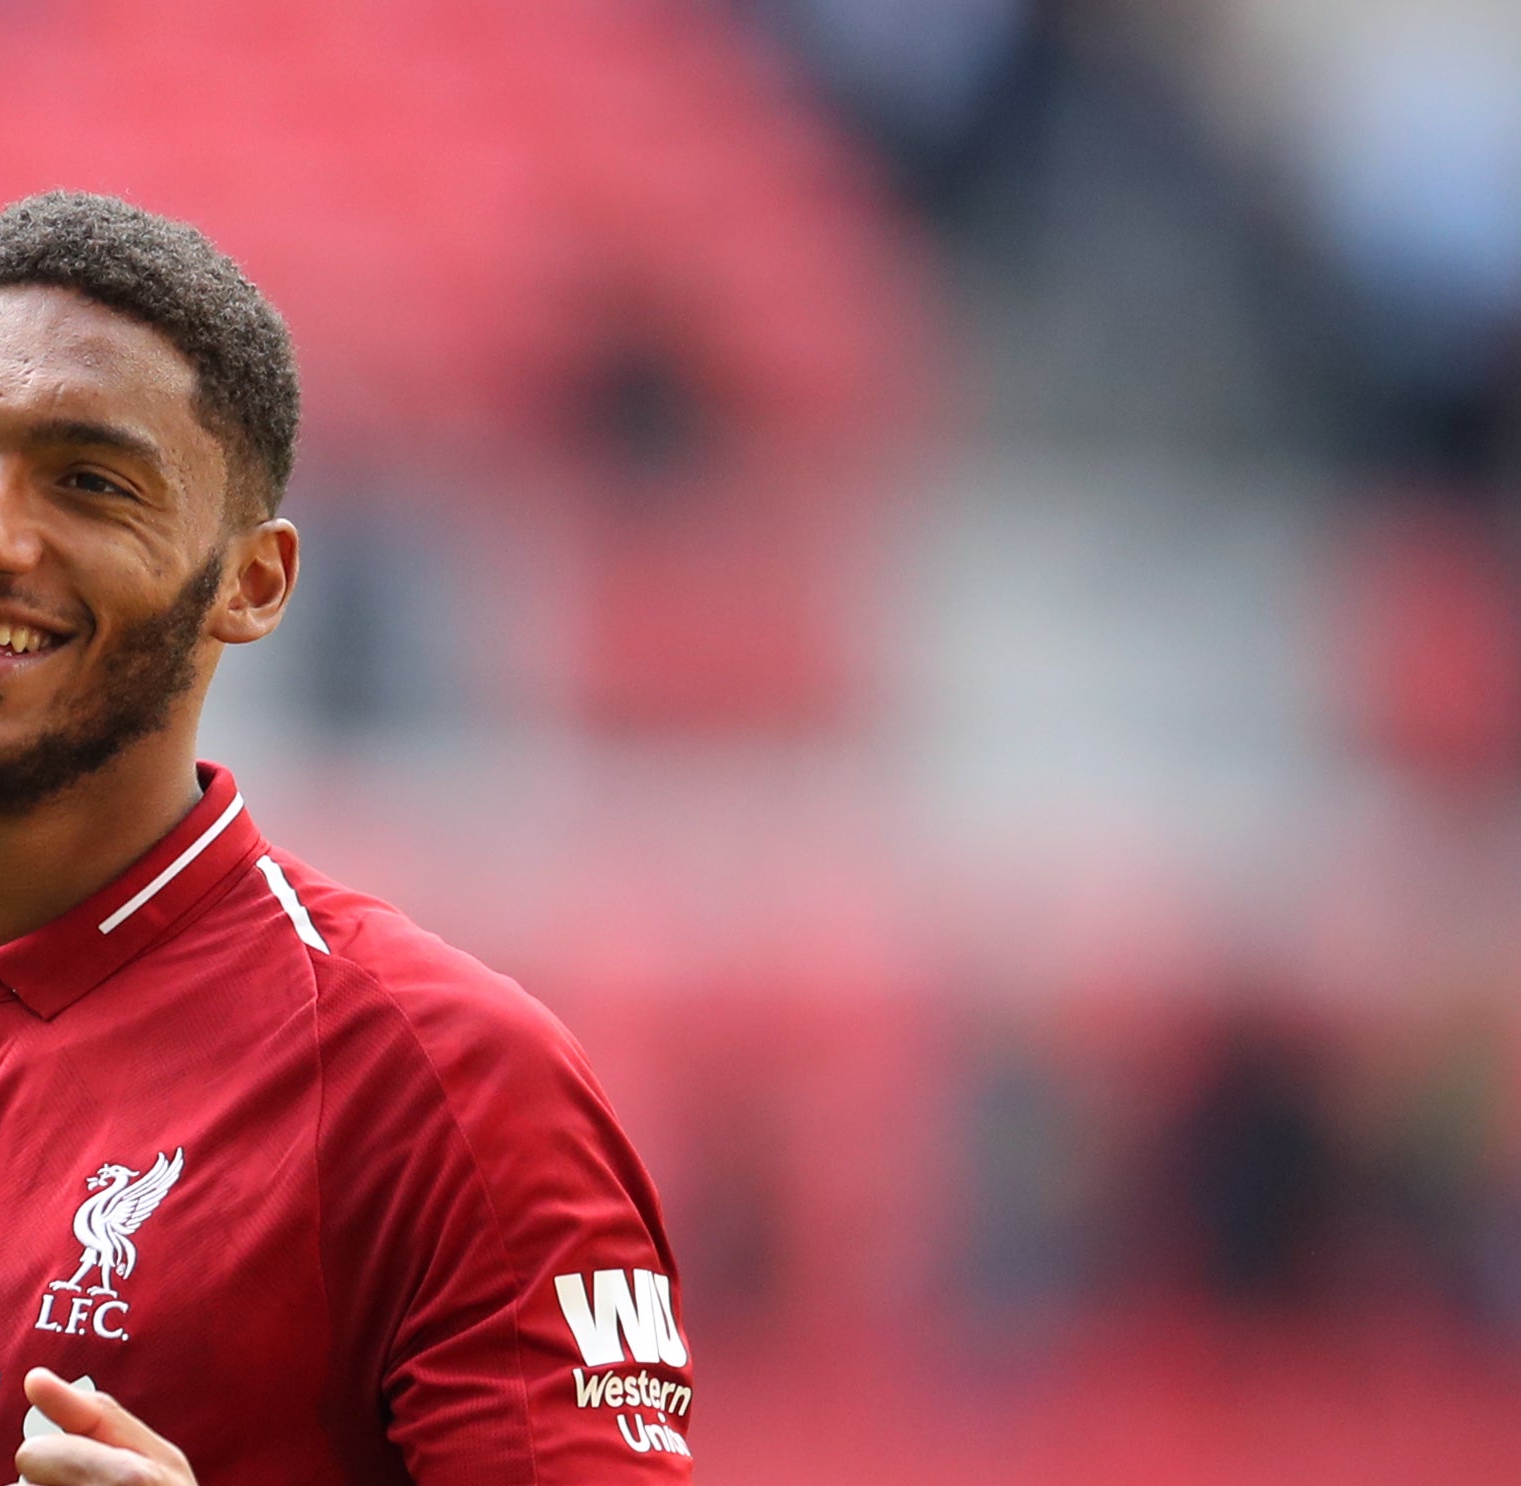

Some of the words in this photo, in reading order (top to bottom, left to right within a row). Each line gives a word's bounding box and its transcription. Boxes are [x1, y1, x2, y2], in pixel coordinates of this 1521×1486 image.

[34, 1294, 130, 1342] L.F.C.
[554, 1268, 688, 1367] WU
[572, 1368, 692, 1416] Western
